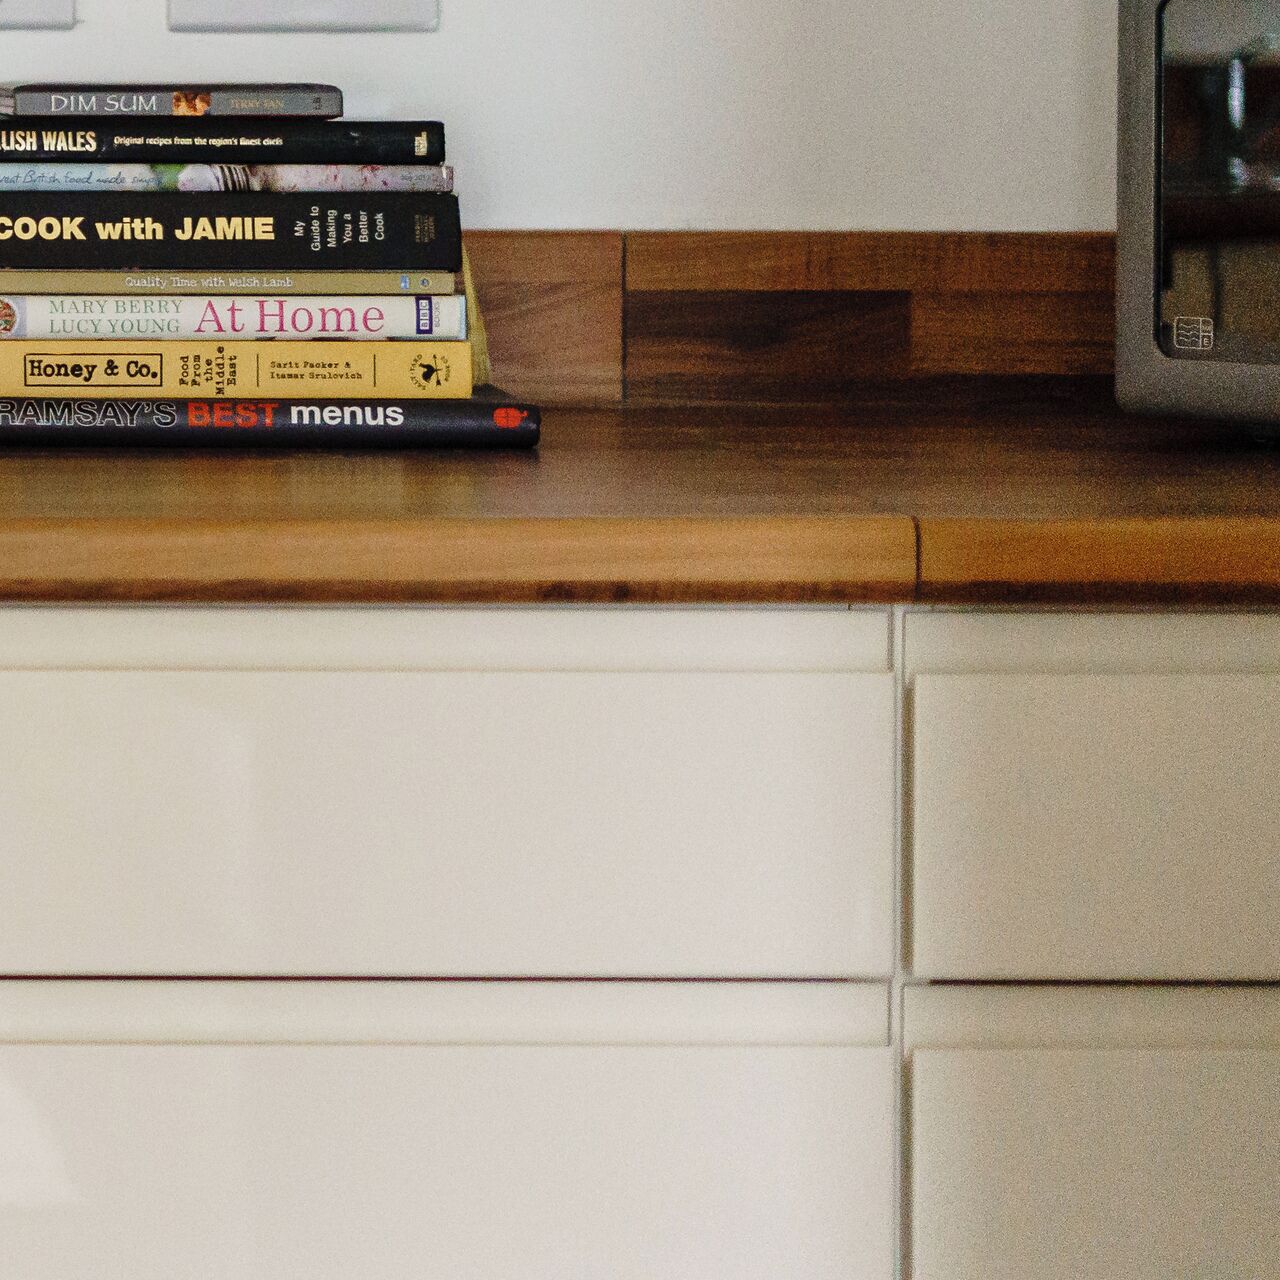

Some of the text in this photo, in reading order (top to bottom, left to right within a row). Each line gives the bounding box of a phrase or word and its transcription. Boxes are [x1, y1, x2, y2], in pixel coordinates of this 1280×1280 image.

[51, 94, 157, 112] DIM SUM
[42, 131, 97, 152] WALES
[113, 136, 144, 147] Original
[146, 137, 172, 147] recipes
[173, 137, 192, 145] from
[194, 137, 207, 145] the
[208, 137, 238, 147] region's
[64, 171, 93, 184] food
[96, 171, 126, 184] made
[95, 218, 163, 240] with
[174, 217, 275, 240] JAMIE
[294, 220, 306, 236] My
[310, 206, 321, 251] Guide to
[326, 209, 338, 248] Making
[342, 223, 353, 244] You
[358, 210, 369, 243] Better
[374, 213, 385, 241] Cook
[125, 277, 167, 289] Quality
[170, 277, 197, 287] Time
[201, 277, 225, 287] with
[263, 277, 294, 287] Lamb
[49, 300, 183, 314] MARY BERRY
[193, 299, 386, 333] At Home
[49, 318, 180, 334] LUCY YOUNG
[29, 359, 158, 382] Honey & Co.
[179, 355, 190, 386] Food
[191, 354, 201, 387] From
[204, 358, 213, 382] the
[215, 345, 225, 396] Middle
[226, 355, 237, 386] East
[270, 361, 352, 369] Sarit Packer &
[270, 372, 363, 380] Itamar Srulovich
[187, 402, 280, 428] BEST
[291, 405, 405, 426] menus
